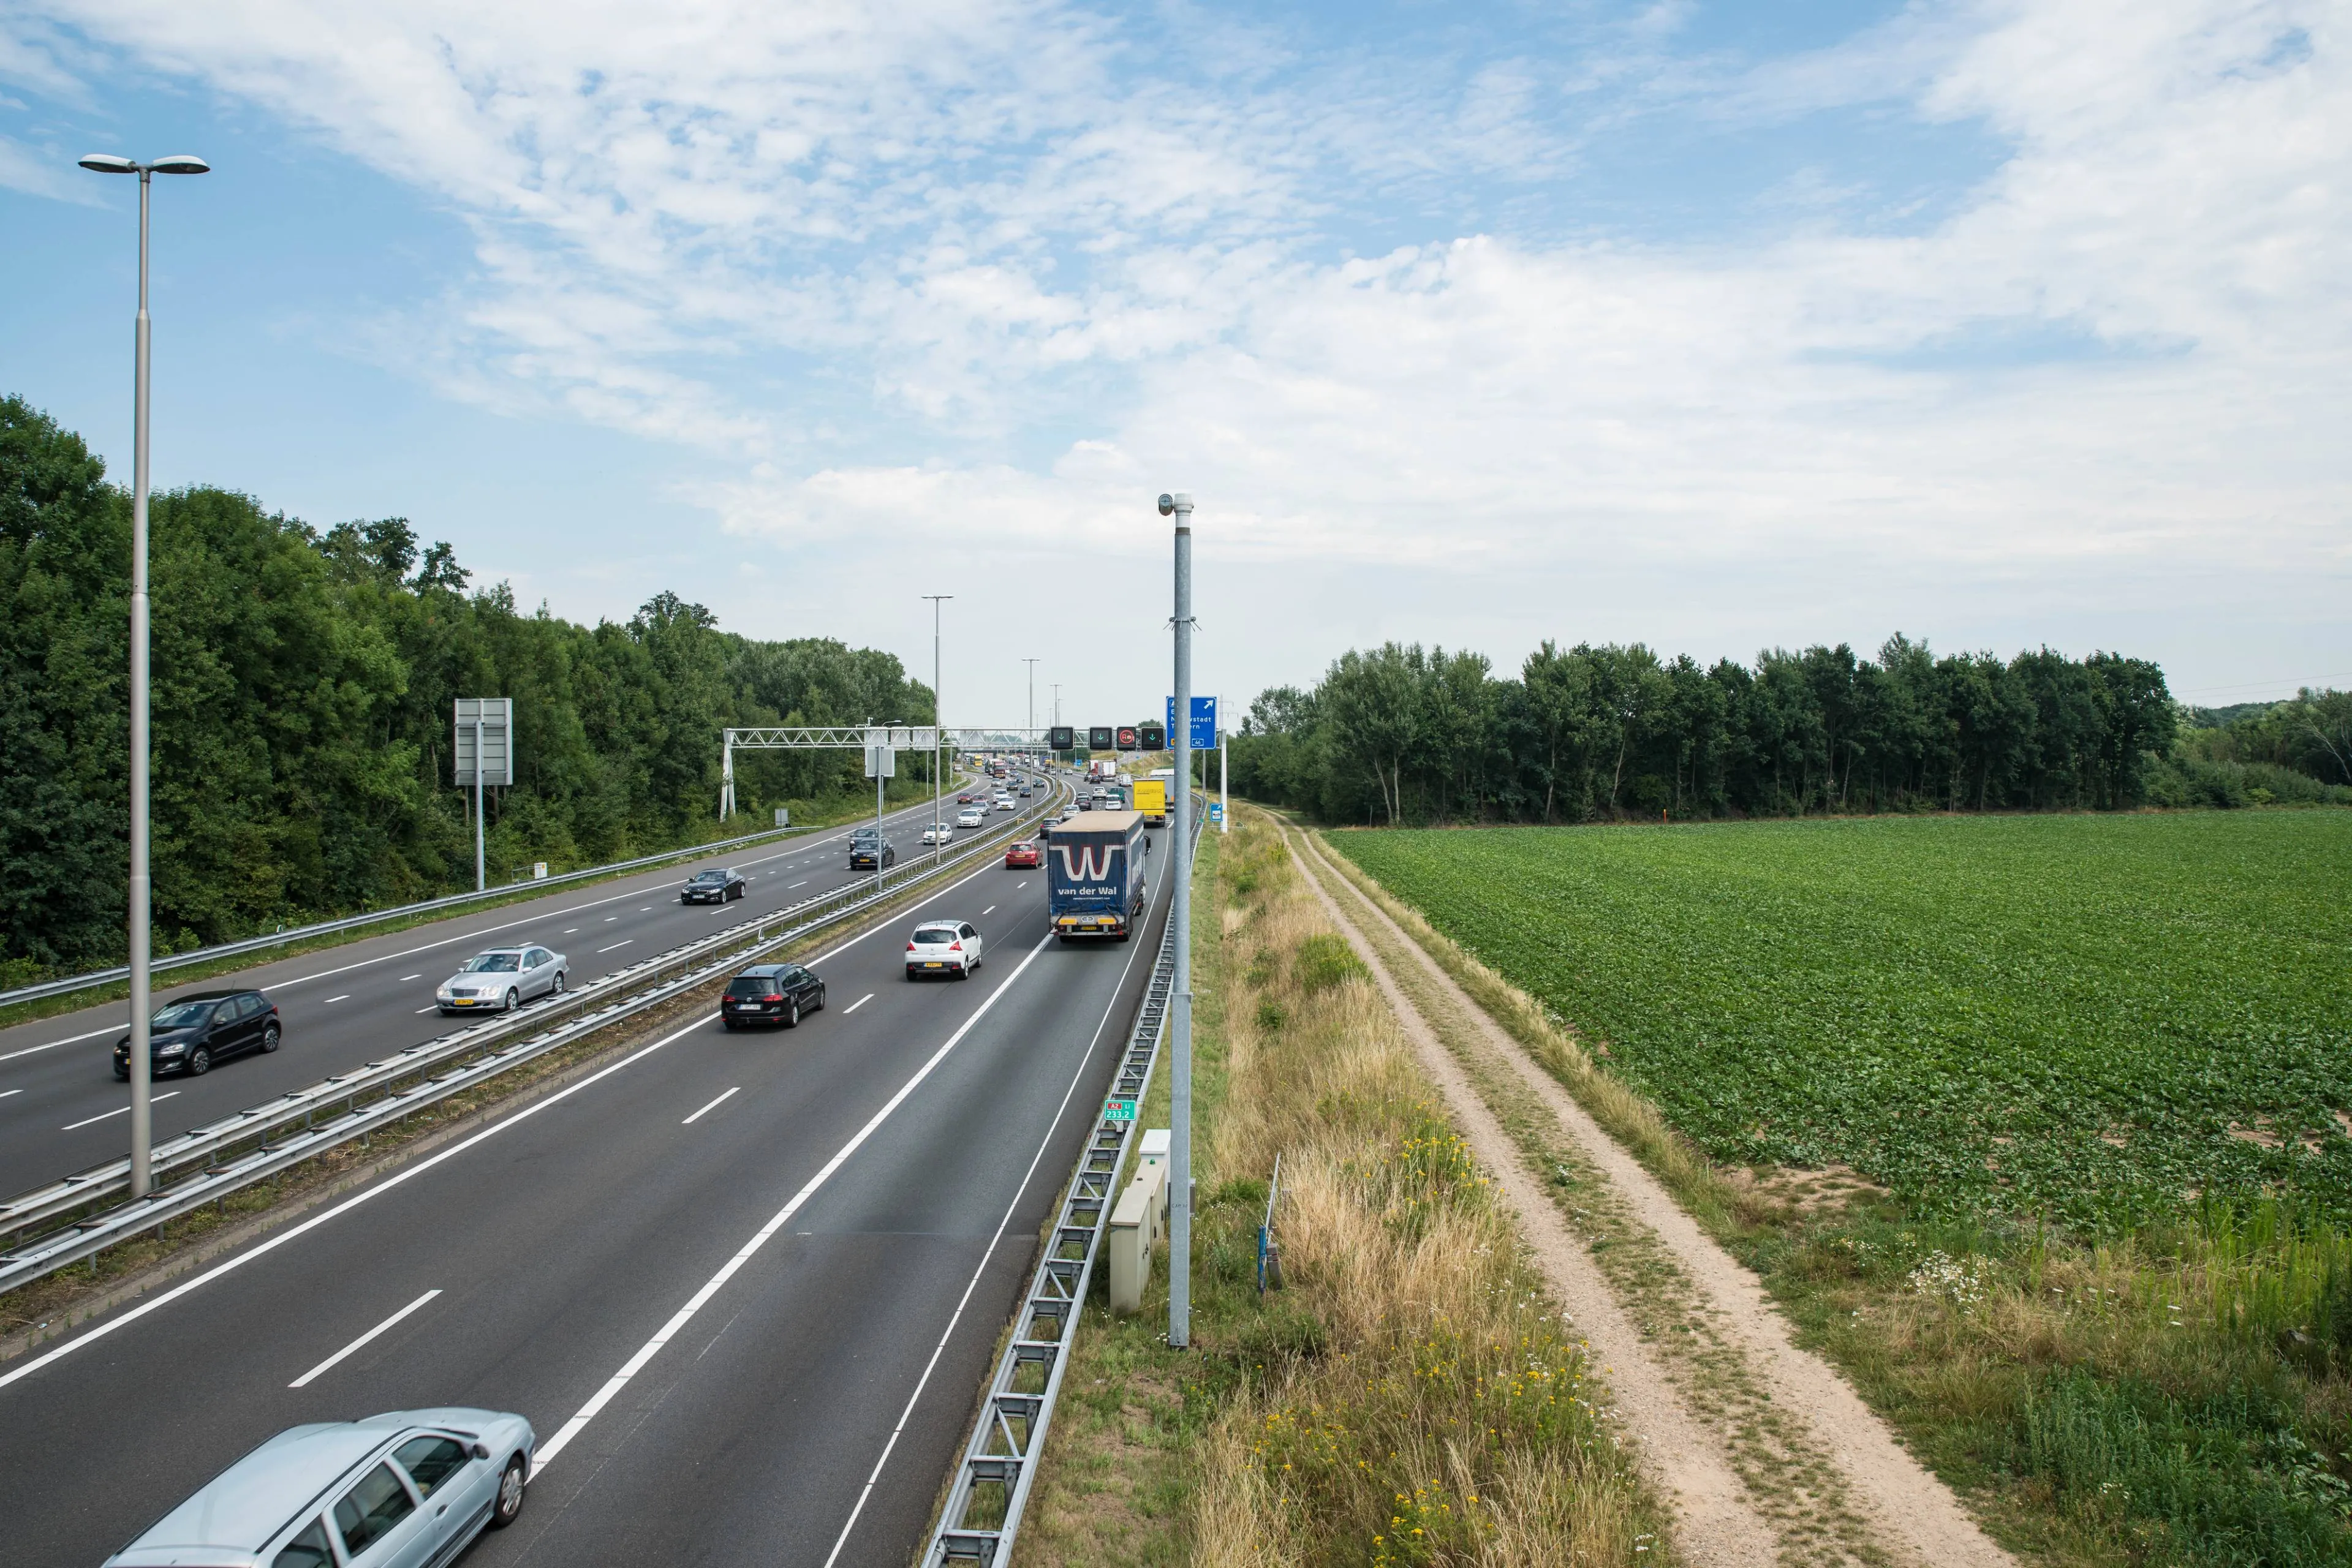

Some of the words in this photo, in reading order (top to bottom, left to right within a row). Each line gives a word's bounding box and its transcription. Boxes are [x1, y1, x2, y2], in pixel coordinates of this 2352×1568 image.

[1079, 886, 1095, 895] der
[1098, 886, 1117, 895] Wal
[1106, 1110, 1130, 1119] 233,2
